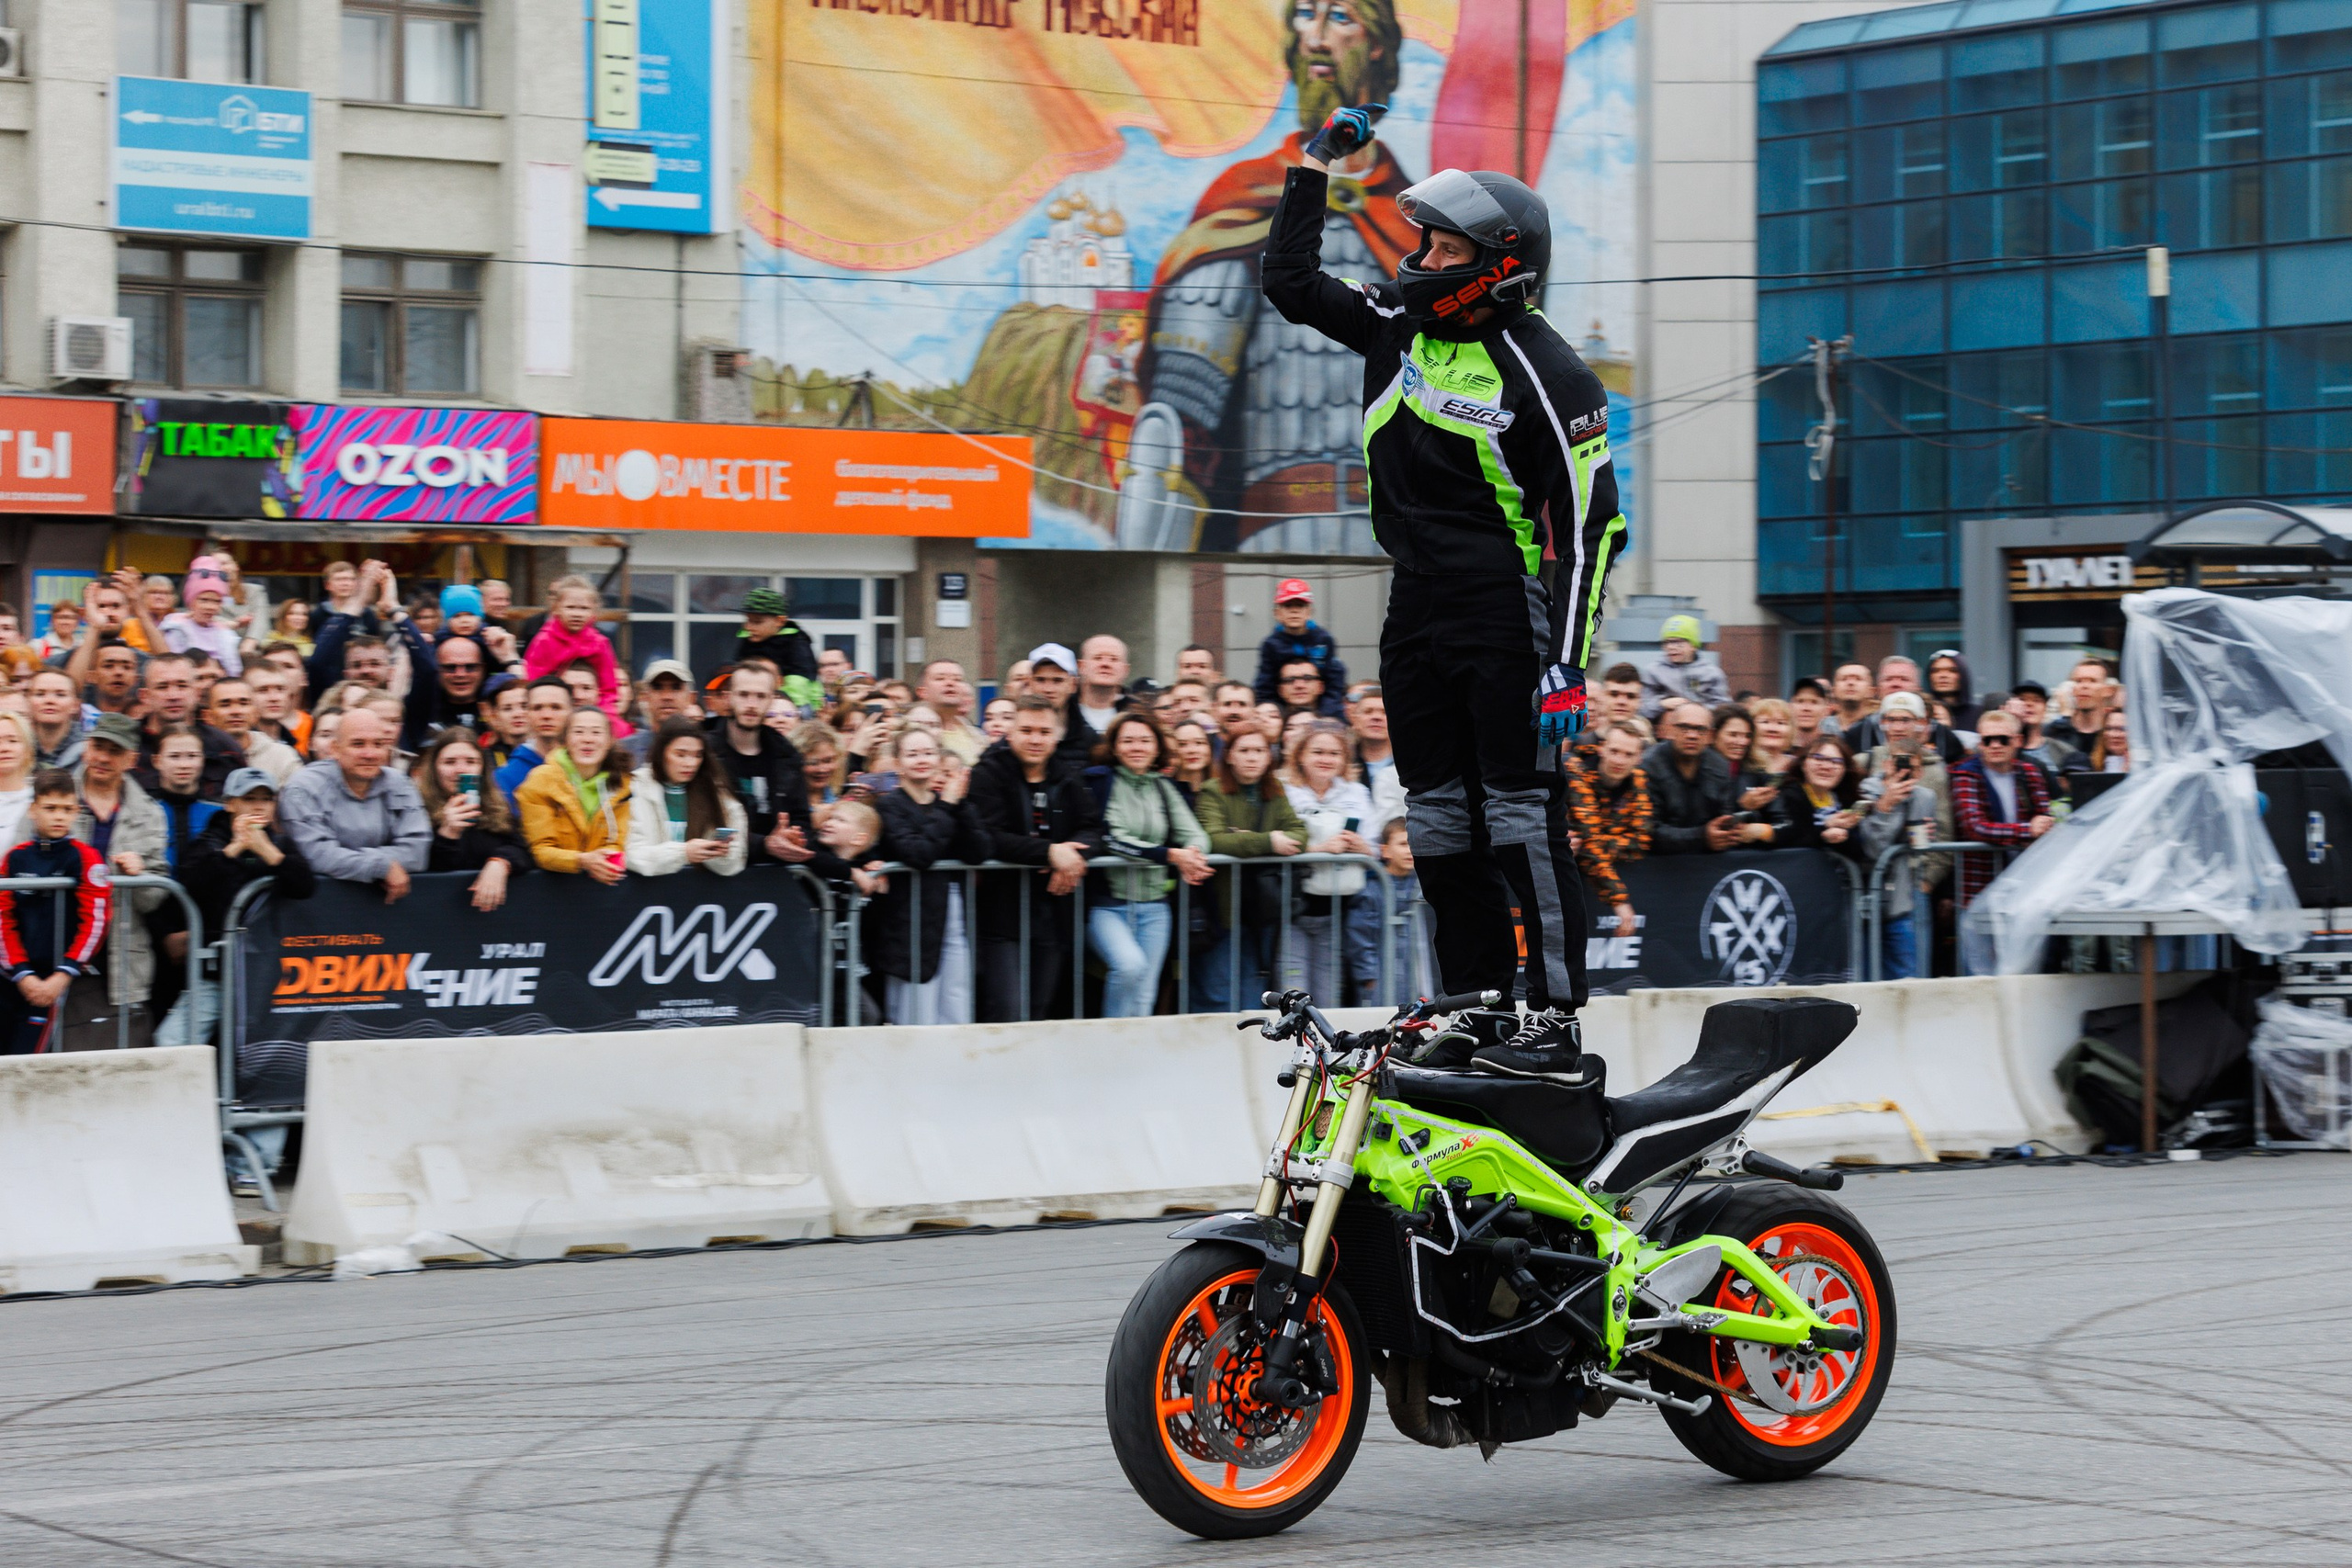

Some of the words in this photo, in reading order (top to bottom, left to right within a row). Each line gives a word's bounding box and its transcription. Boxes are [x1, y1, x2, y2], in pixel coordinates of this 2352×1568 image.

[1432, 255, 1521, 318] SENA
[157, 421, 280, 458] ТАБАК
[337, 443, 507, 488] OZON
[659, 454, 793, 502] ВМЕСТЕ
[1596, 915, 1646, 929] УРЛ
[480, 942, 547, 959] УРАЛ
